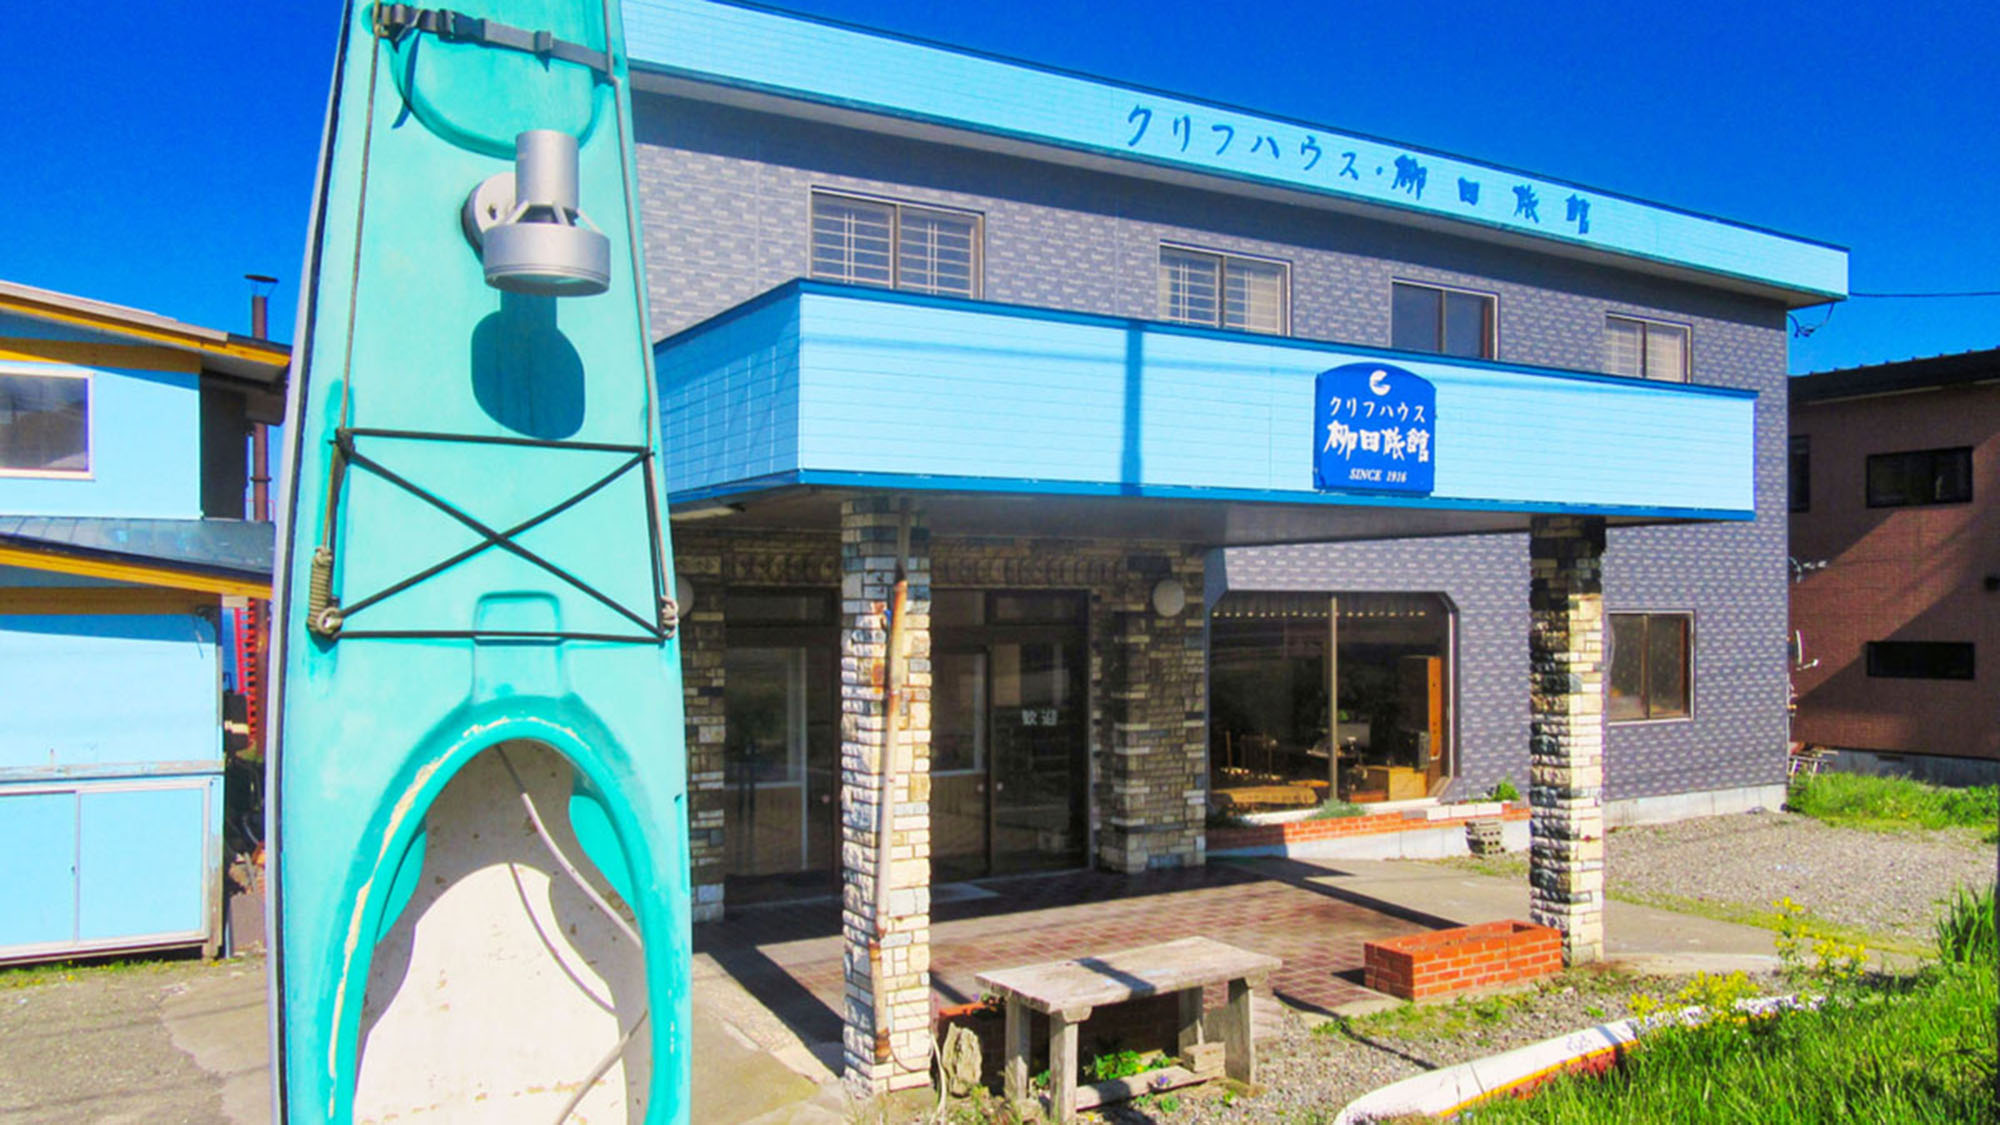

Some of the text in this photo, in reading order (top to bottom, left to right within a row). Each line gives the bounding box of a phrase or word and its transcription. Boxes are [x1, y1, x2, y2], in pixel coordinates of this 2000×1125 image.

[1329, 396, 1426, 423] クリフハウス
[1323, 420, 1430, 462] 柳田旅館
[1349, 468, 1382, 482] SINCE
